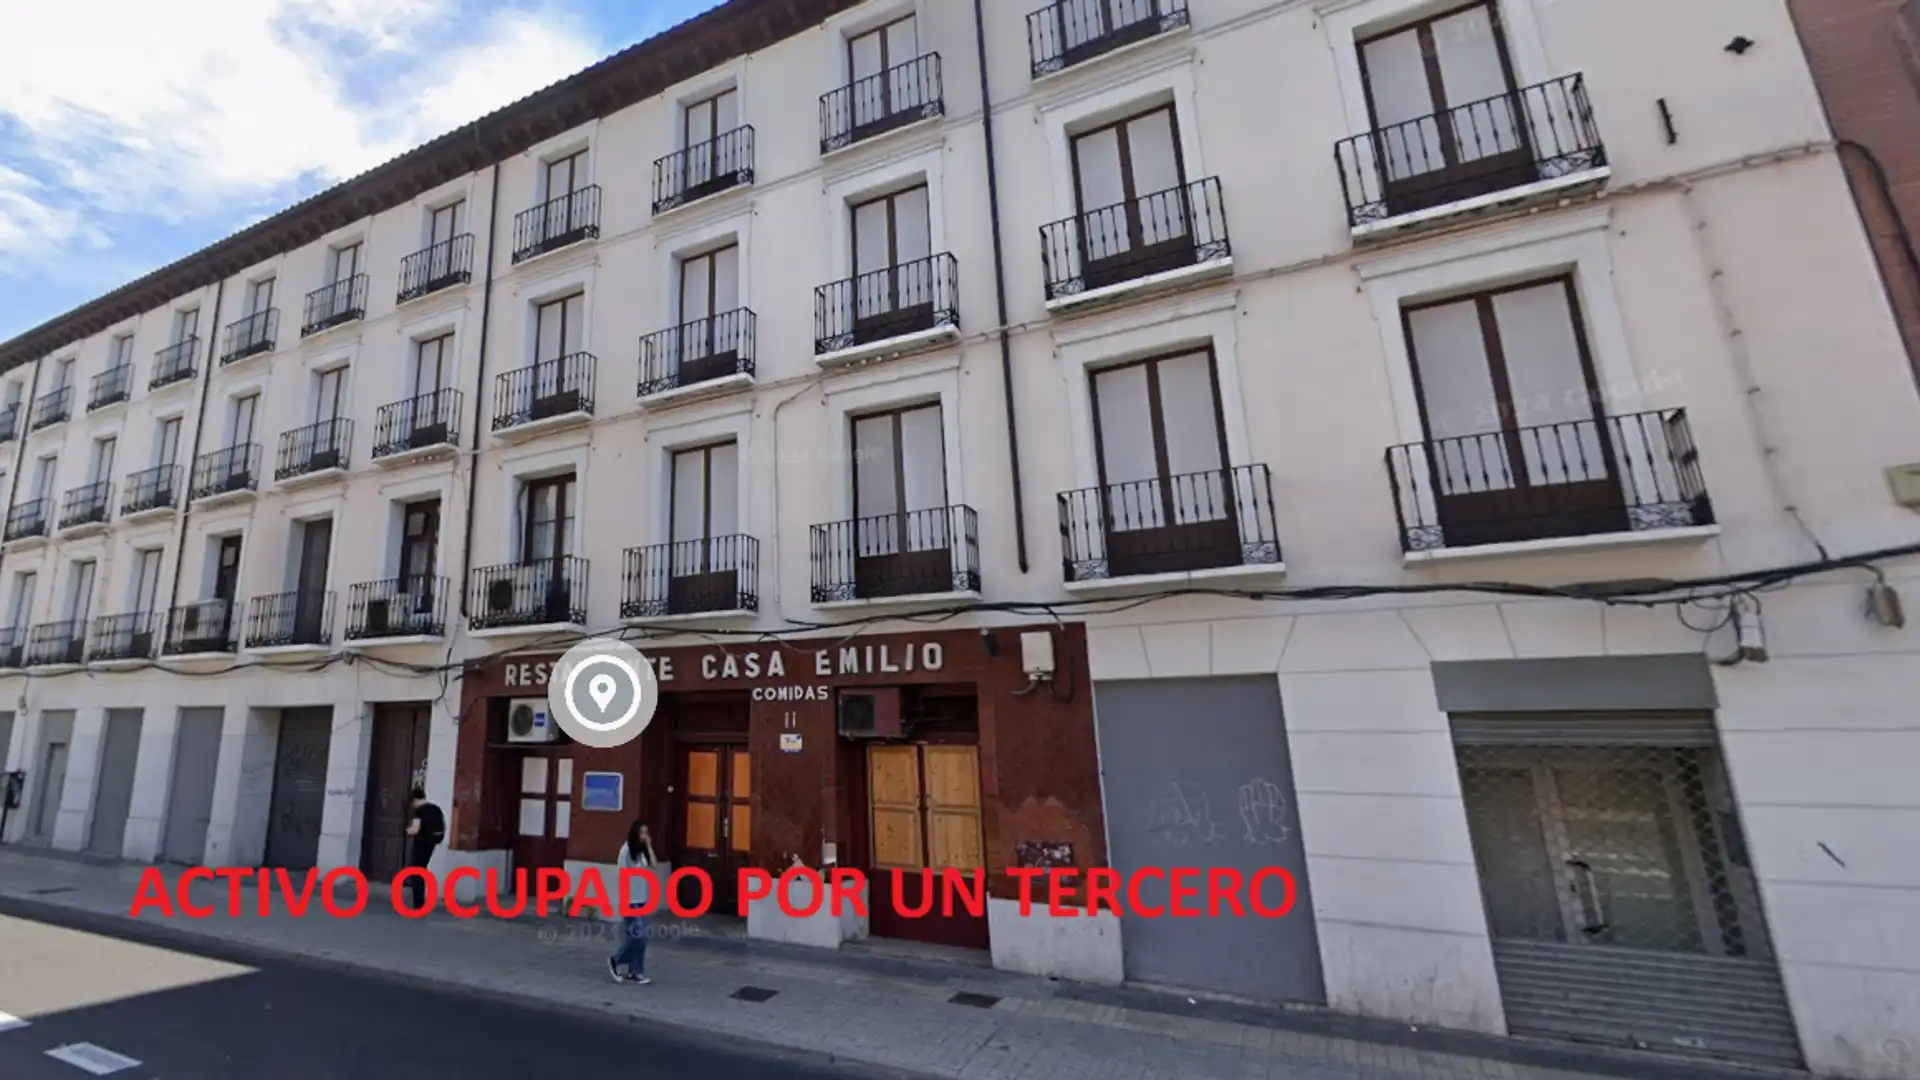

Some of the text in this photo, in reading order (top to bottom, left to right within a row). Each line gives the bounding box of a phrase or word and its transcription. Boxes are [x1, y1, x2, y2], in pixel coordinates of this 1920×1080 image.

[505, 642, 943, 687] RESTANTE CASA EMILIO
[752, 685, 829, 701] COMIDAS
